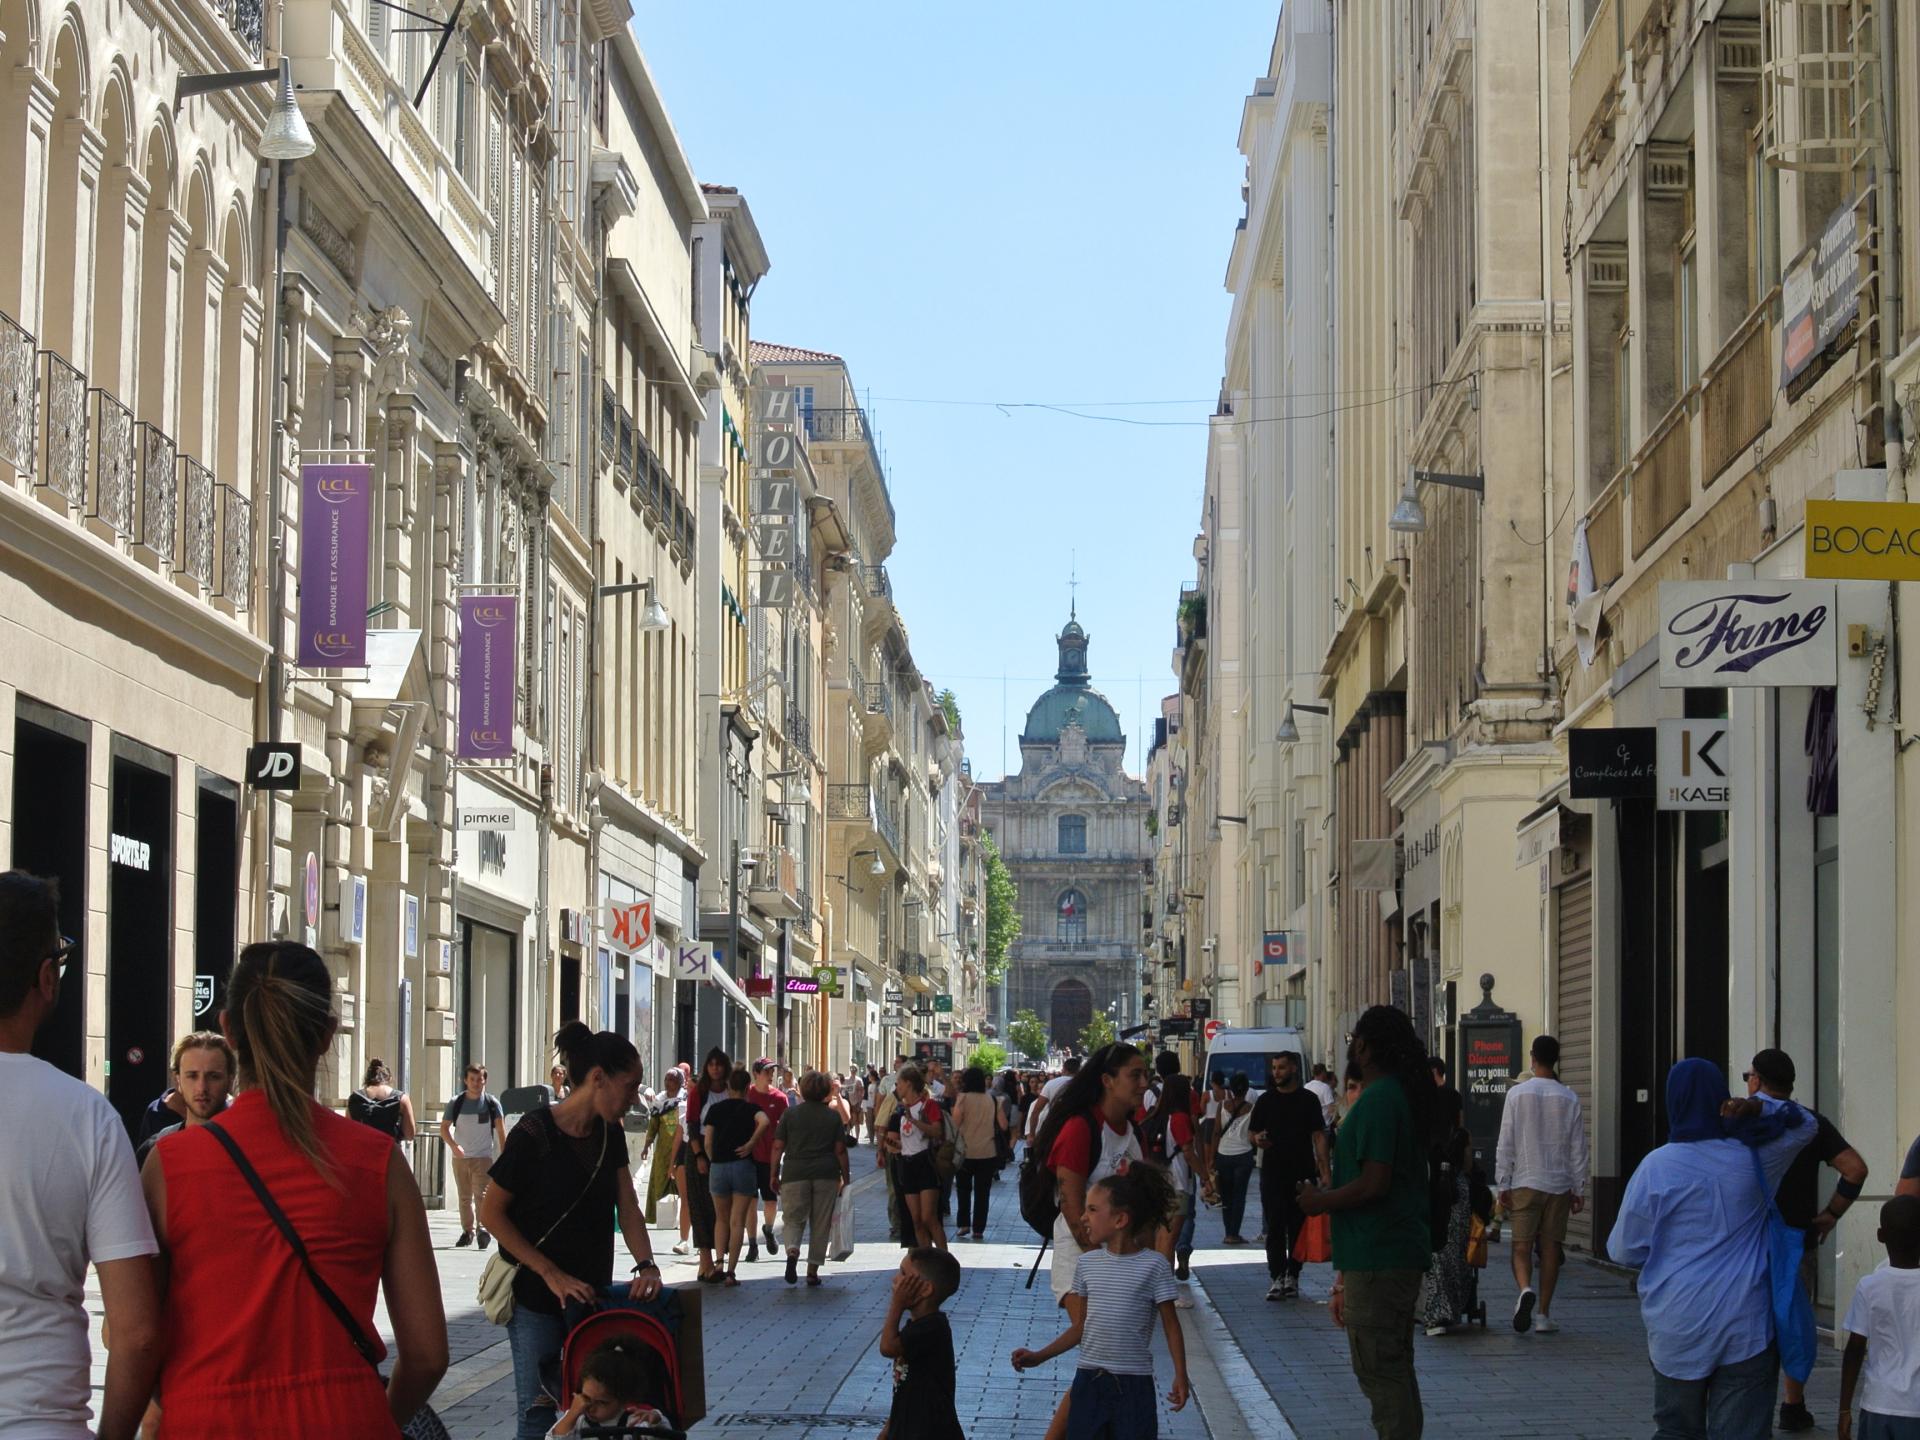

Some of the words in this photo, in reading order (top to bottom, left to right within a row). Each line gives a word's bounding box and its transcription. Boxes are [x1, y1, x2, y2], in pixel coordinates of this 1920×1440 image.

[321, 479, 356, 491] LCL
[763, 390, 792, 603] HOTEL
[330, 509, 339, 566] ASSURANCE
[331, 567, 338, 581] ET
[330, 582, 338, 626] BANQUE
[476, 608, 503, 618] LCL
[1667, 592, 1827, 673] Fame
[318, 633, 352, 645] LCL
[484, 679, 491, 690] ET
[474, 731, 497, 741] LCL
[258, 752, 294, 778] JD
[1575, 763, 1628, 780] Complices
[1631, 764, 1643, 777] de
[463, 813, 510, 825] pimkie
[195, 987, 210, 995] NG
[786, 980, 818, 991] Etam
[1473, 1040, 1504, 1051] Phone
[1468, 1054, 1509, 1065] Discount
[1478, 1069, 1487, 1078] DU
[1488, 1068, 1510, 1078] MOBILE
[1476, 1085, 1489, 1093] PRIX
